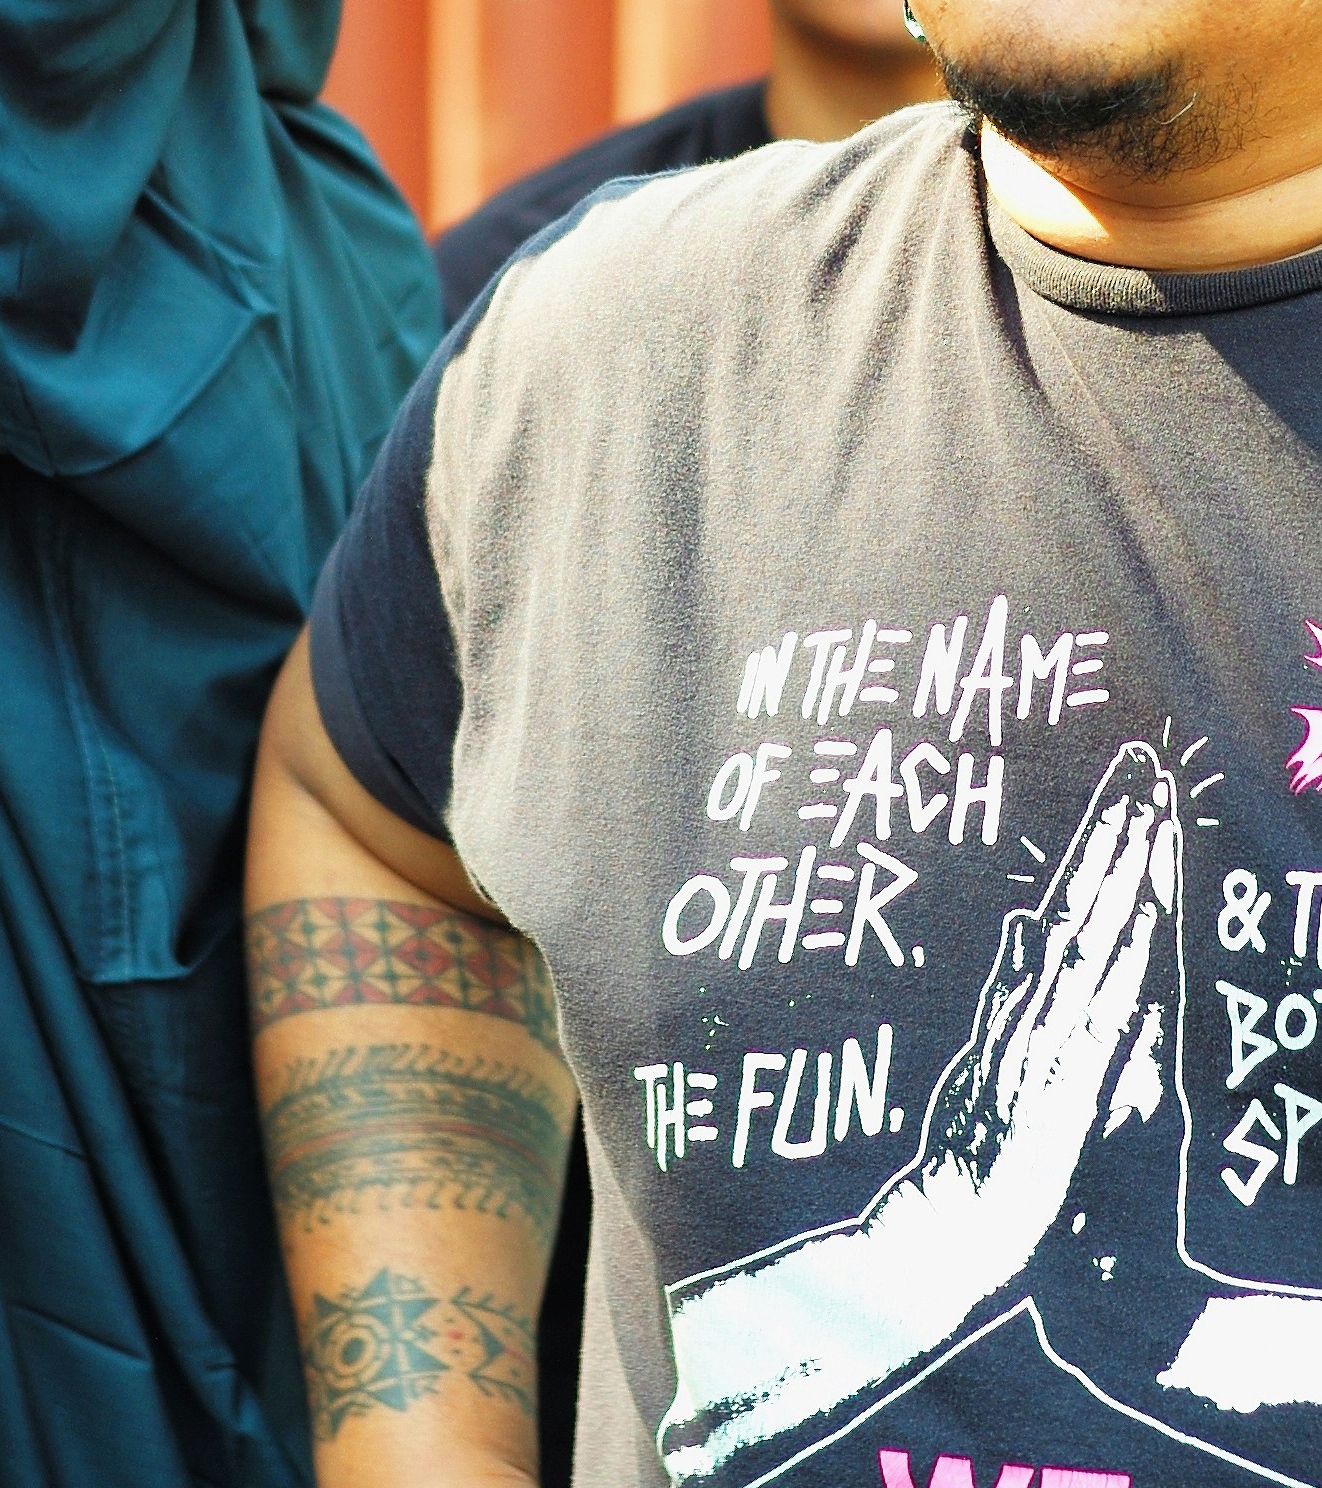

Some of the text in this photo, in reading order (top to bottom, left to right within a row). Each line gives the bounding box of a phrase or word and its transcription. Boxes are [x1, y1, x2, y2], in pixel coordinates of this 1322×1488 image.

[736, 593, 1111, 747] IN THE NAME
[705, 727, 1006, 848] OF EACH
[1216, 867, 1273, 955] &
[633, 1060, 719, 1173] THE
